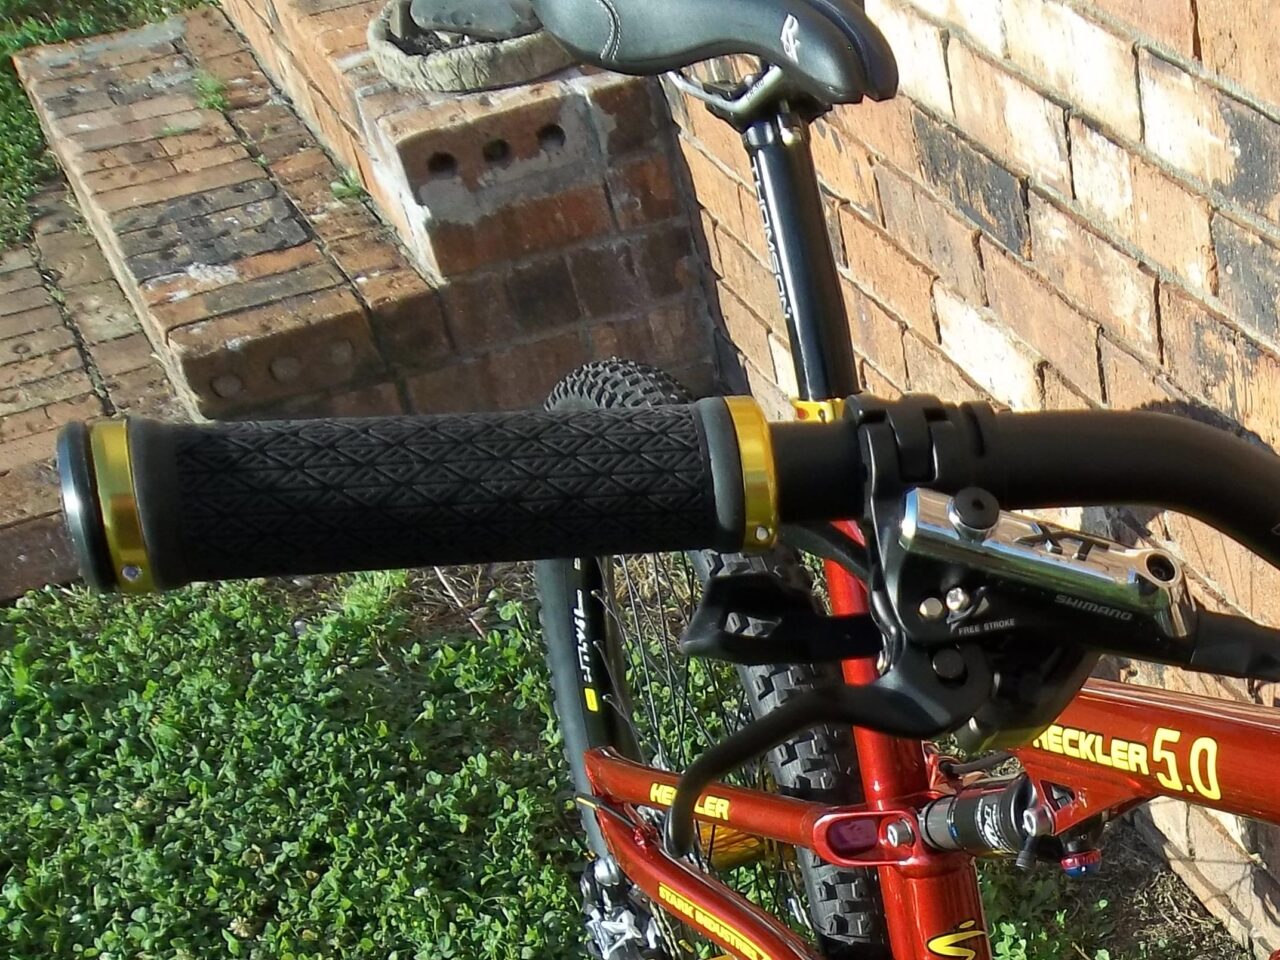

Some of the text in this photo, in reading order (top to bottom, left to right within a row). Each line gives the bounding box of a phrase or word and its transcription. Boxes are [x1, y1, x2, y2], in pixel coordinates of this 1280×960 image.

[1054, 593, 1133, 622] SHIMANO
[958, 618, 1016, 636] FREE STROKE
[1152, 727, 1222, 801] 5.0
[650, 783, 731, 821] HELER
